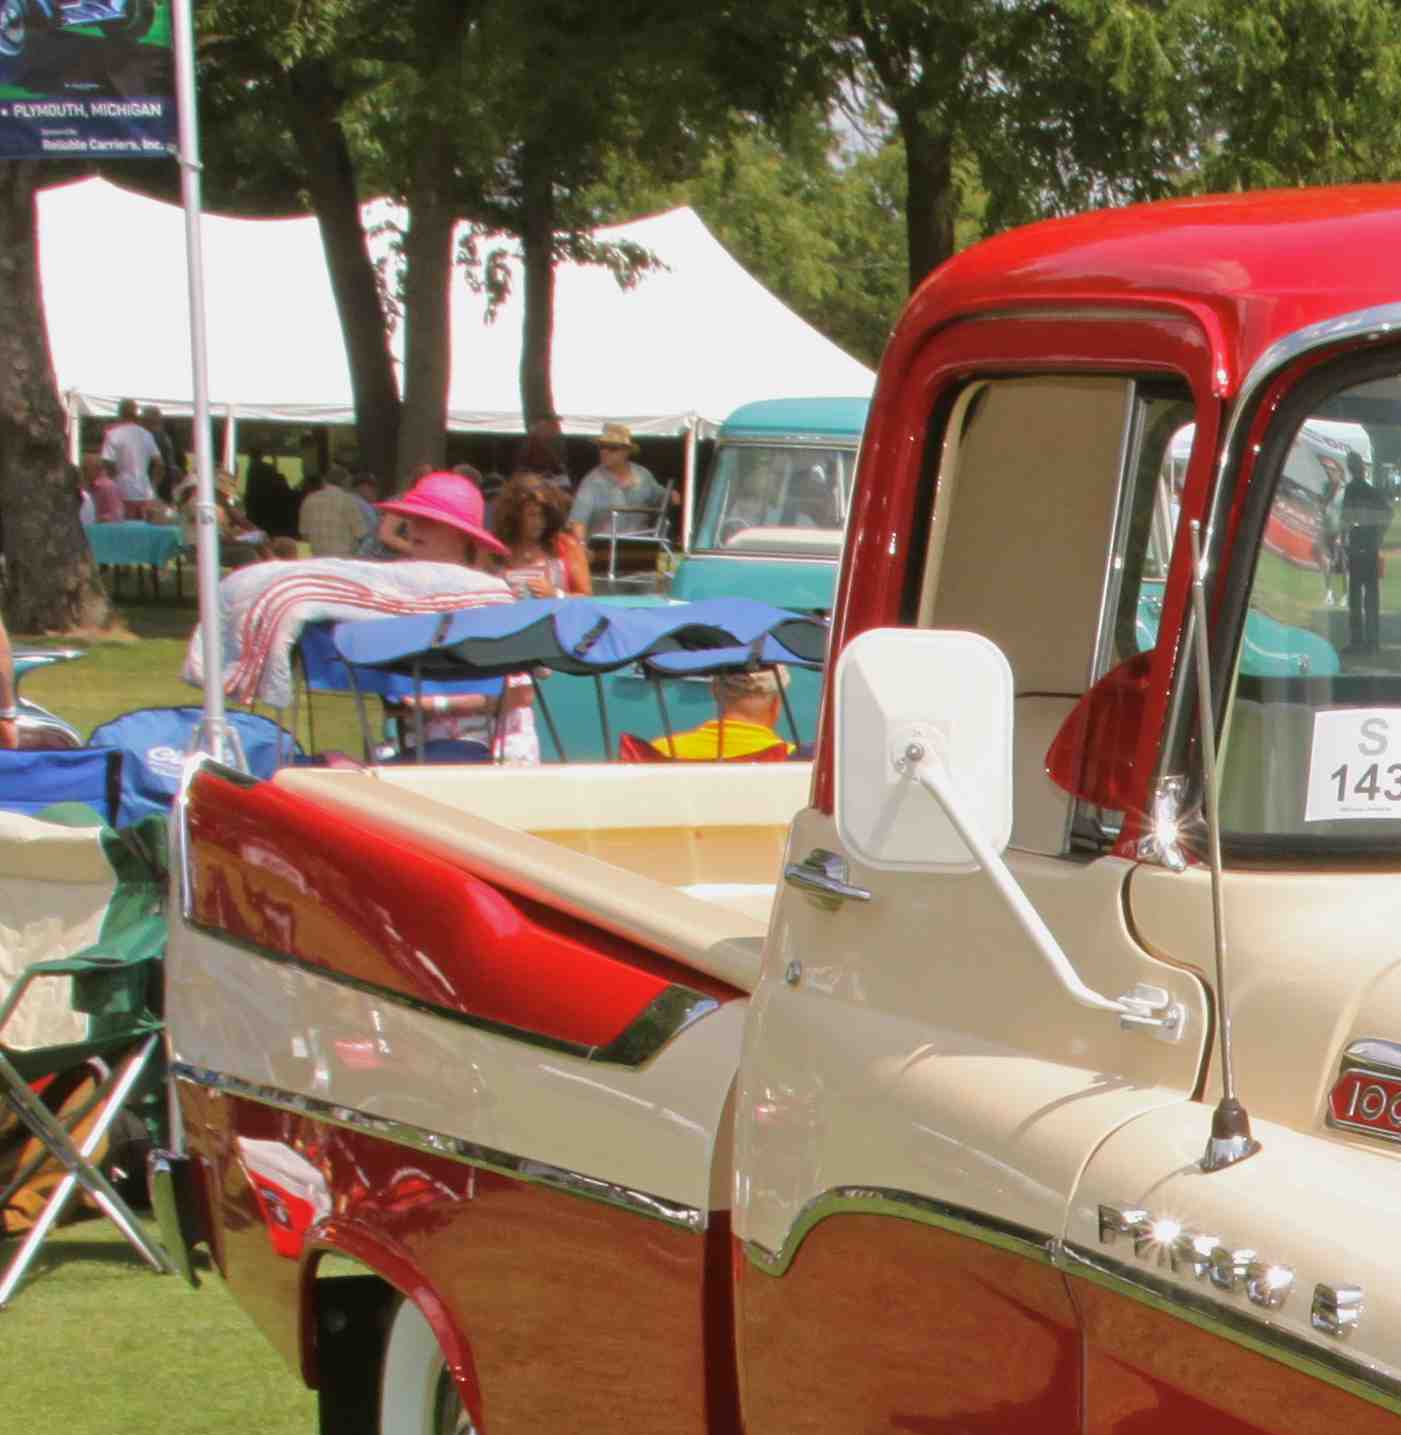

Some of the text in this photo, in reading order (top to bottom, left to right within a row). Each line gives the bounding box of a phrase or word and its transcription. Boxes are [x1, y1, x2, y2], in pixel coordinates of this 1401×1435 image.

[13, 103, 162, 119] PLYMOUTH, MICHIGAN
[1358, 717, 1389, 757] S
